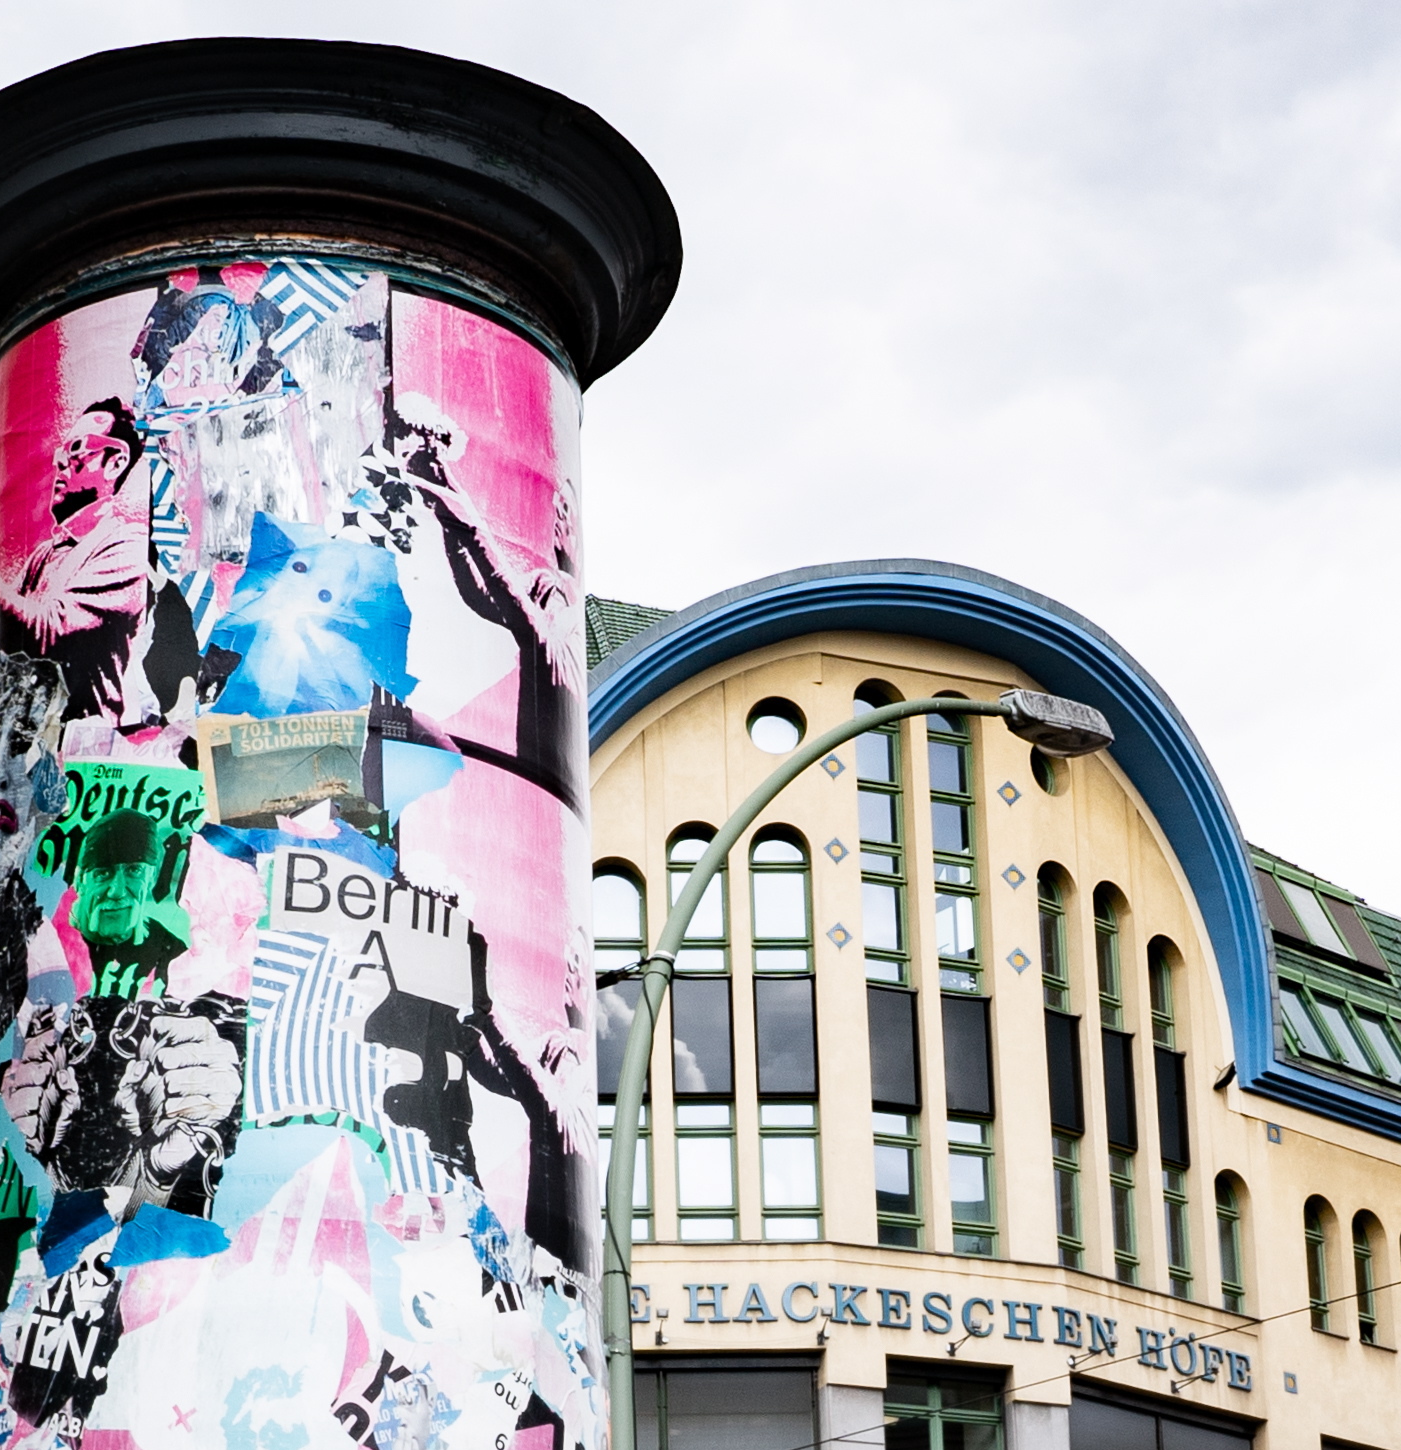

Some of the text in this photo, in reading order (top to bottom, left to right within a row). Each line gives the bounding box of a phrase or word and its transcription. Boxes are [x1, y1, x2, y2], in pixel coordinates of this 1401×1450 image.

[238, 715, 356, 738] 701 TONNEN
[683, 1281, 1119, 1356] HACKESCHEN
[1135, 1326, 1254, 1393] HÖFE
